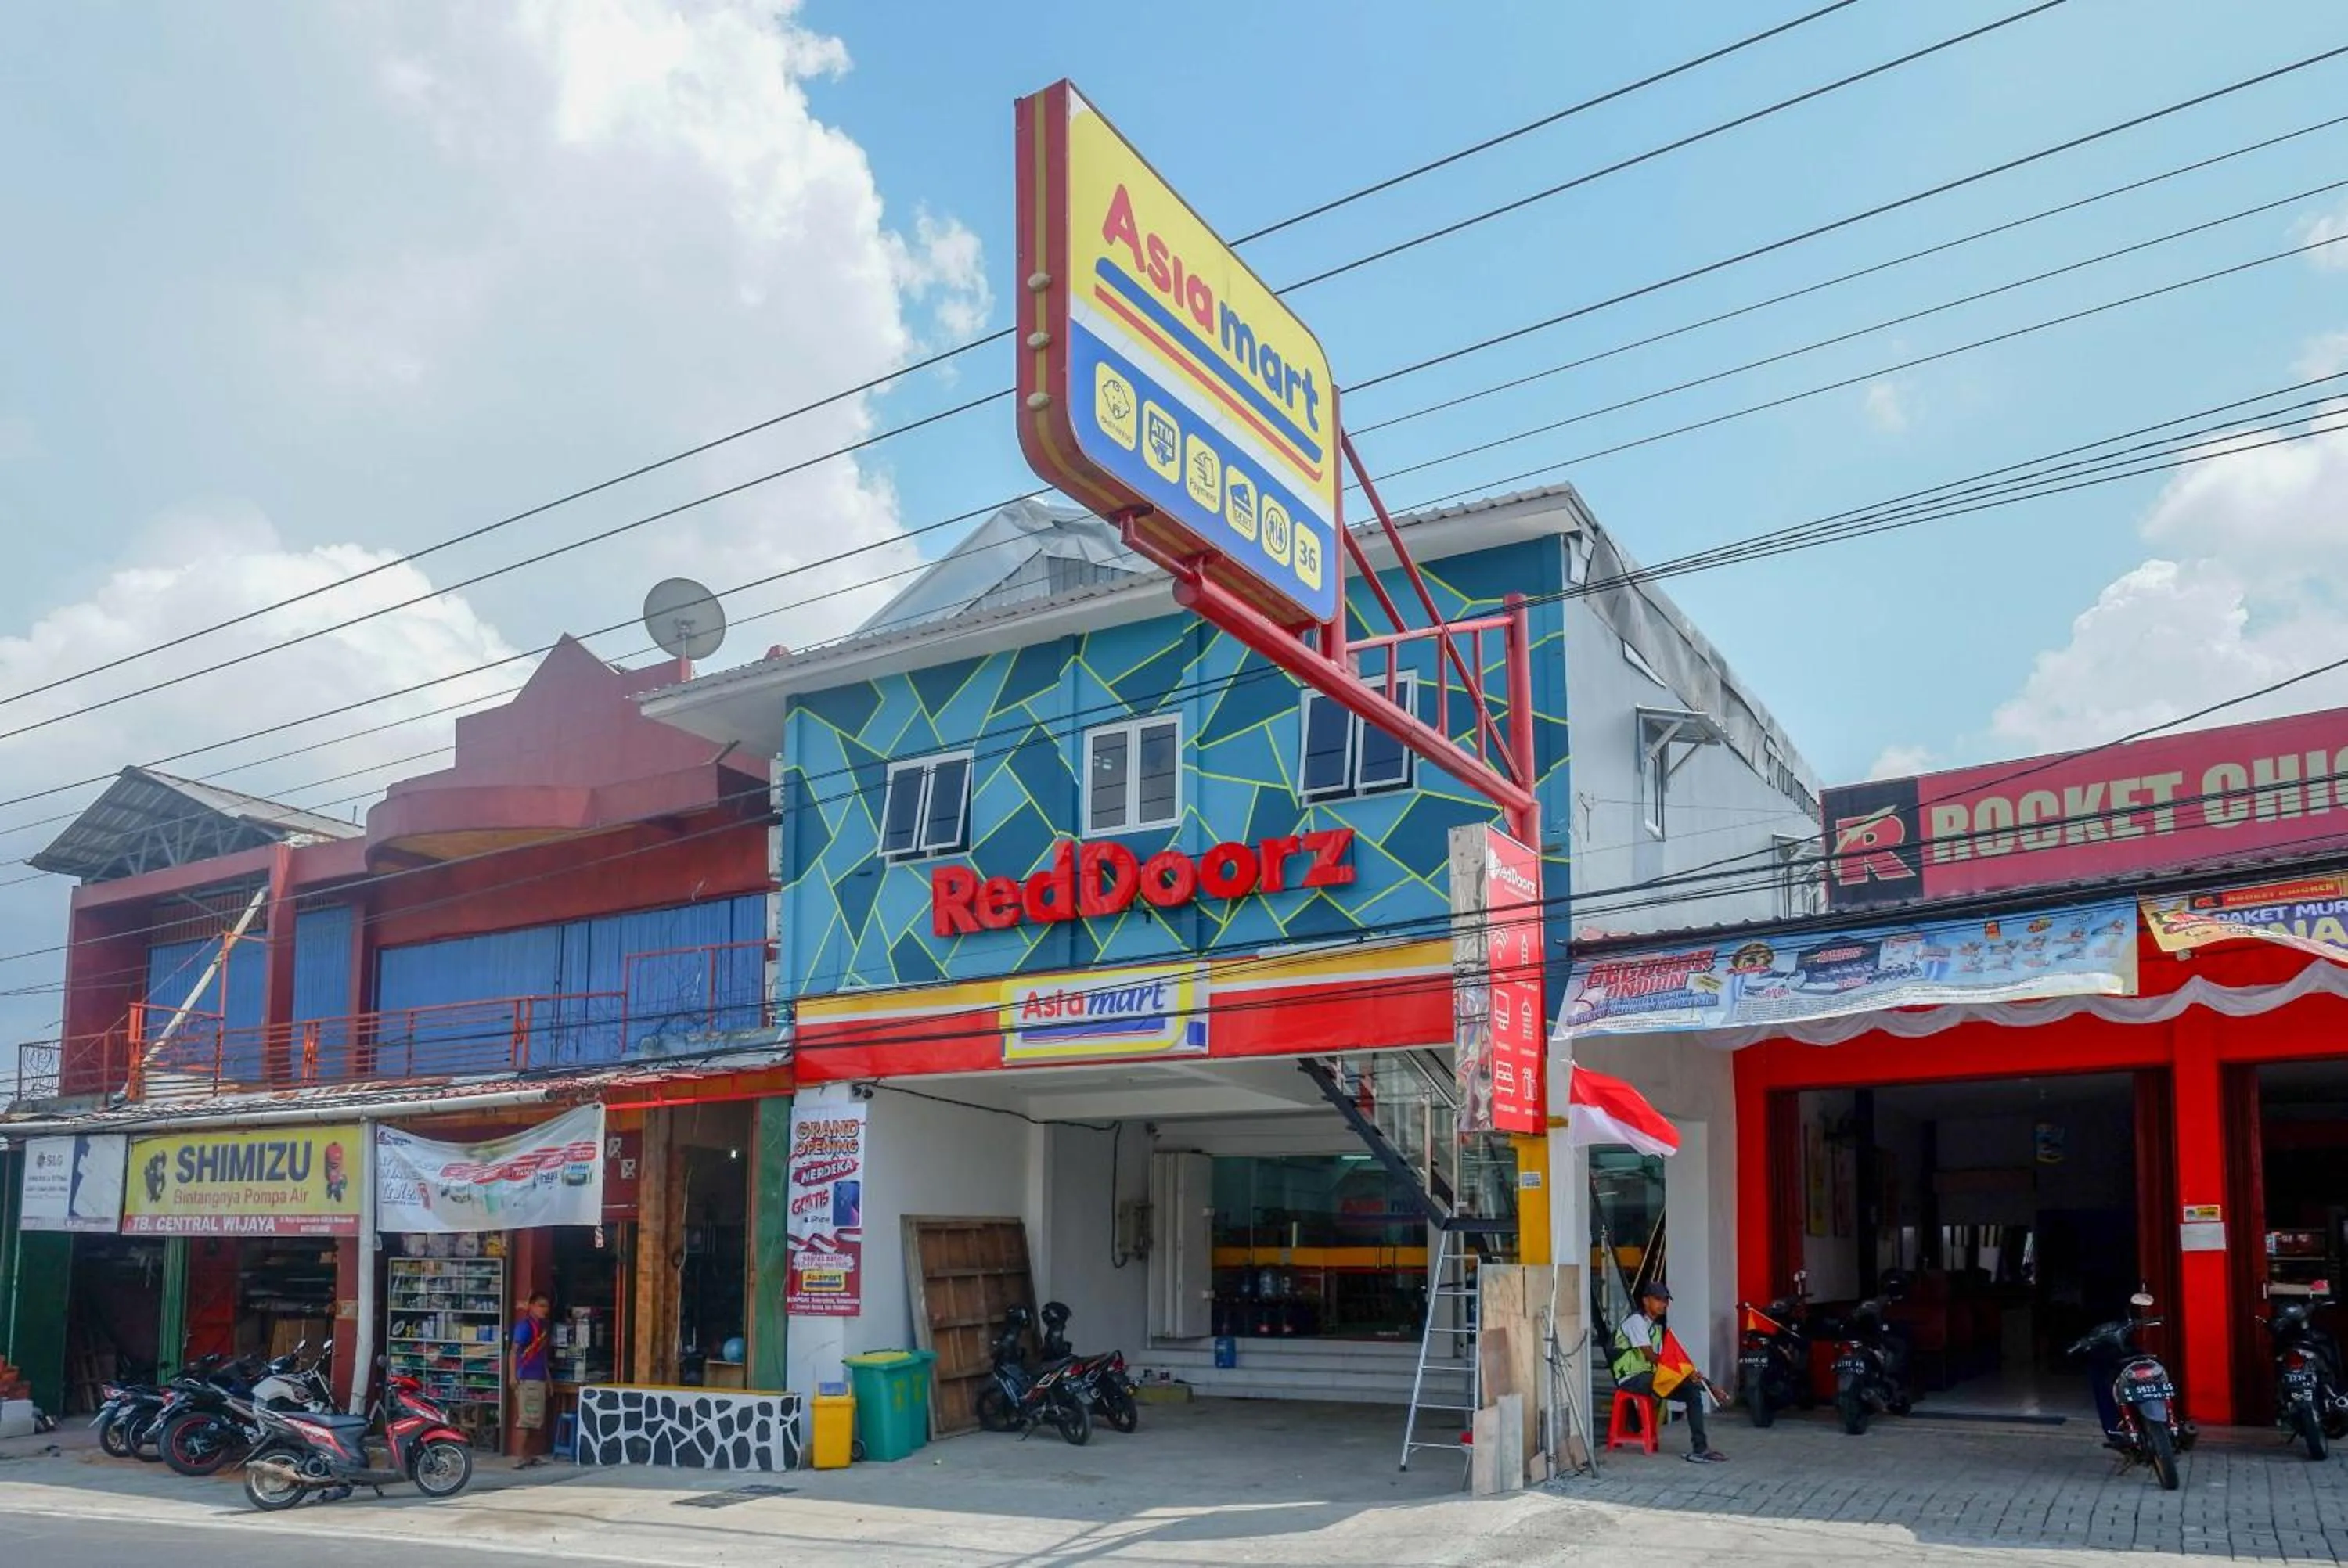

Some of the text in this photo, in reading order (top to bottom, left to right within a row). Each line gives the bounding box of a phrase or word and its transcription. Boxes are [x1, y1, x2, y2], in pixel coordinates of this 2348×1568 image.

[1151, 418, 1174, 444] ATM
[1298, 539, 1317, 574] 36
[1931, 771, 2183, 864] ROCKET
[931, 826, 1356, 937] RedDoorz
[795, 1119, 859, 1140] GRAND
[795, 1138, 859, 1157] OPENING
[175, 1138, 312, 1184] SHIMIZU
[173, 1187, 309, 1208] Bintangnya Pompa Air
[158, 1216, 218, 1232] CENTRAL
[222, 1216, 276, 1232] WIJAYA
